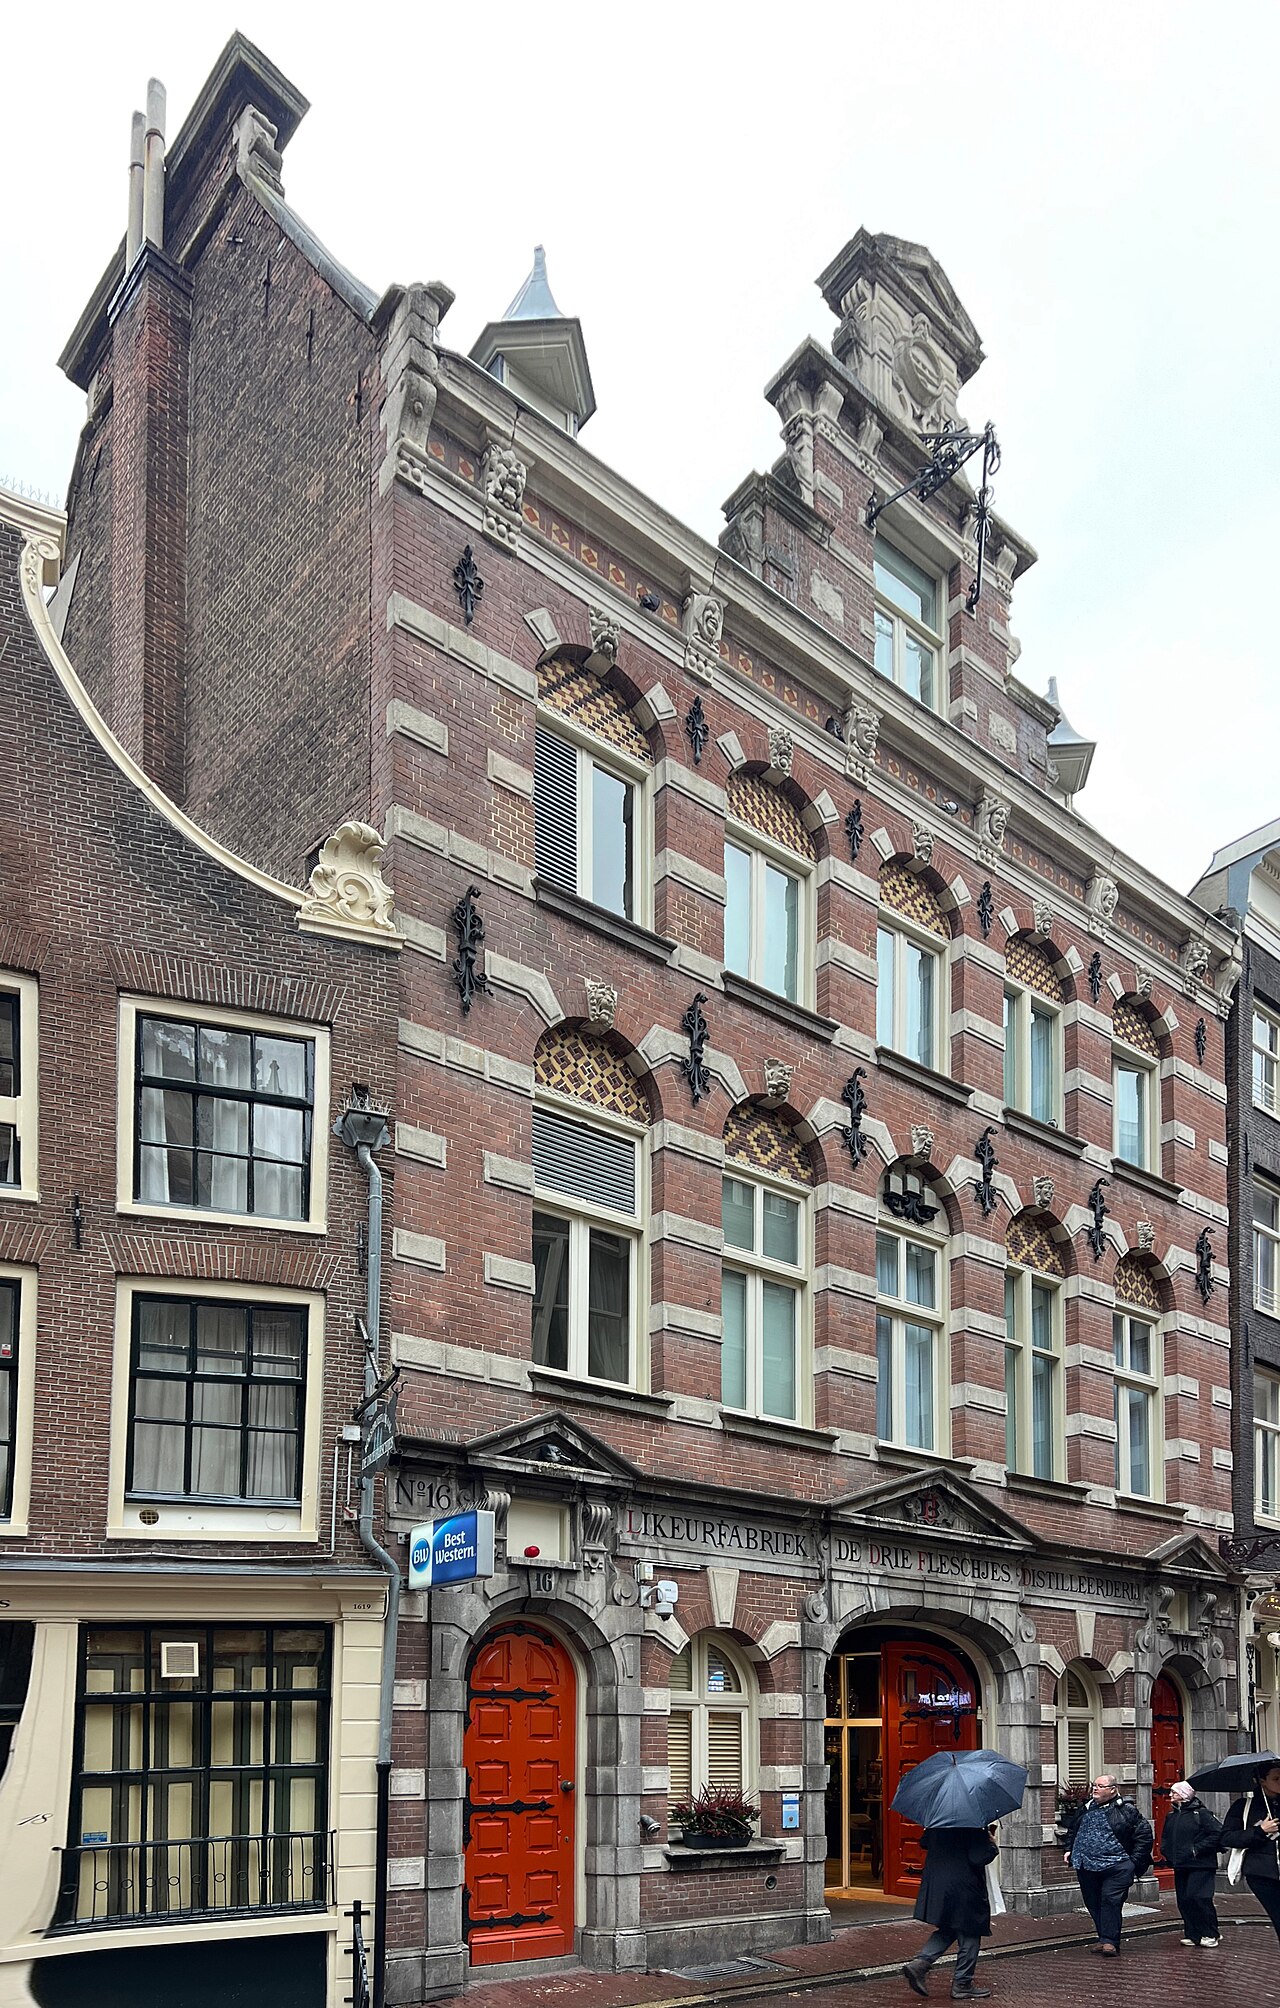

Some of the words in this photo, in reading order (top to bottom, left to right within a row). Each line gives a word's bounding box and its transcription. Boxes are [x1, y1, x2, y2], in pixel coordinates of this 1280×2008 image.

[444, 1530, 466, 1548] Best
[413, 1547, 429, 1565] BW
[434, 1545, 475, 1565] Western
[835, 1538, 862, 1563] DE
[868, 1543, 912, 1570] DRIE
[535, 1572, 553, 1592] 16
